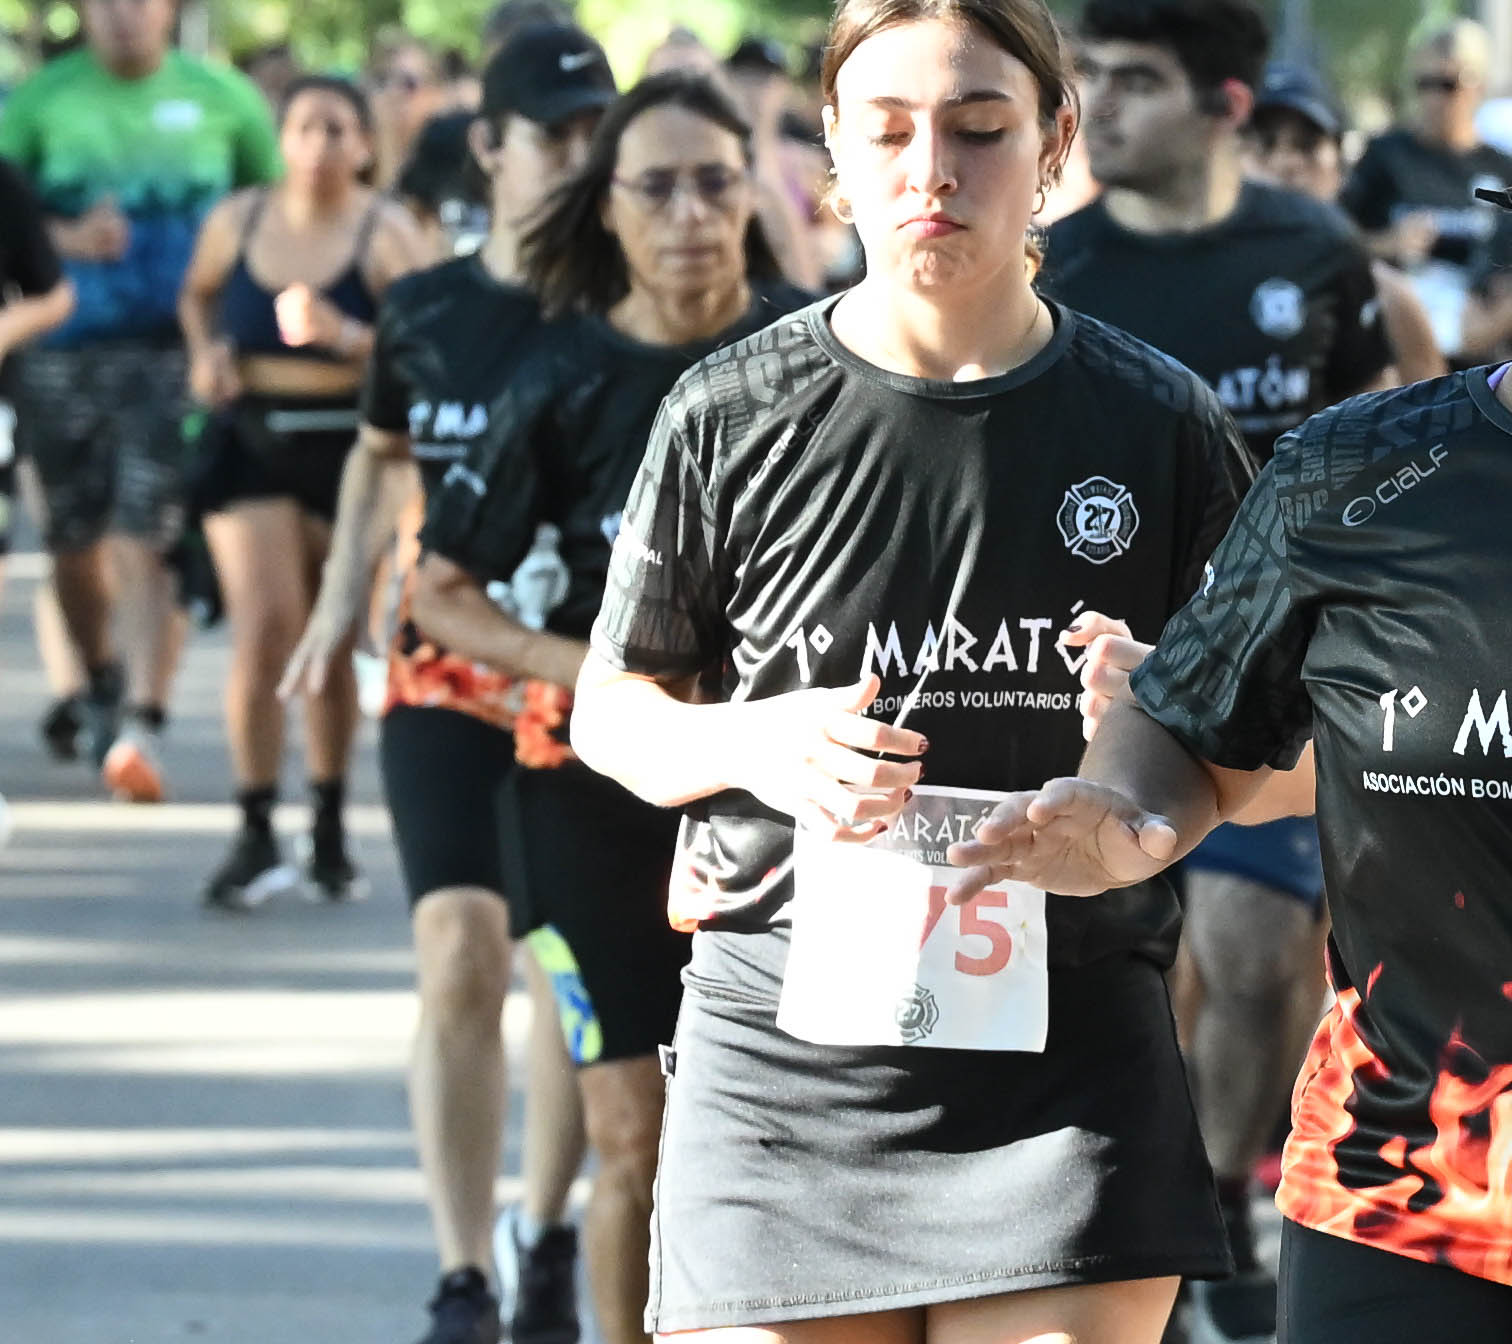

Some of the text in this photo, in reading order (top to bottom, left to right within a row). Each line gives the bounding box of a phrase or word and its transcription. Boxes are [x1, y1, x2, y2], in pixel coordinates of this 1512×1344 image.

[1215, 353, 1310, 408] ATÓN
[1084, 503, 1116, 532] 27
[860, 598, 1092, 679] MARATÓ
[873, 690, 956, 715] BOMEROS
[960, 690, 1072, 712] VOLUNTARIOS
[1362, 768, 1466, 799] ASOCIACIÓN
[891, 806, 990, 844] ARATÓ
